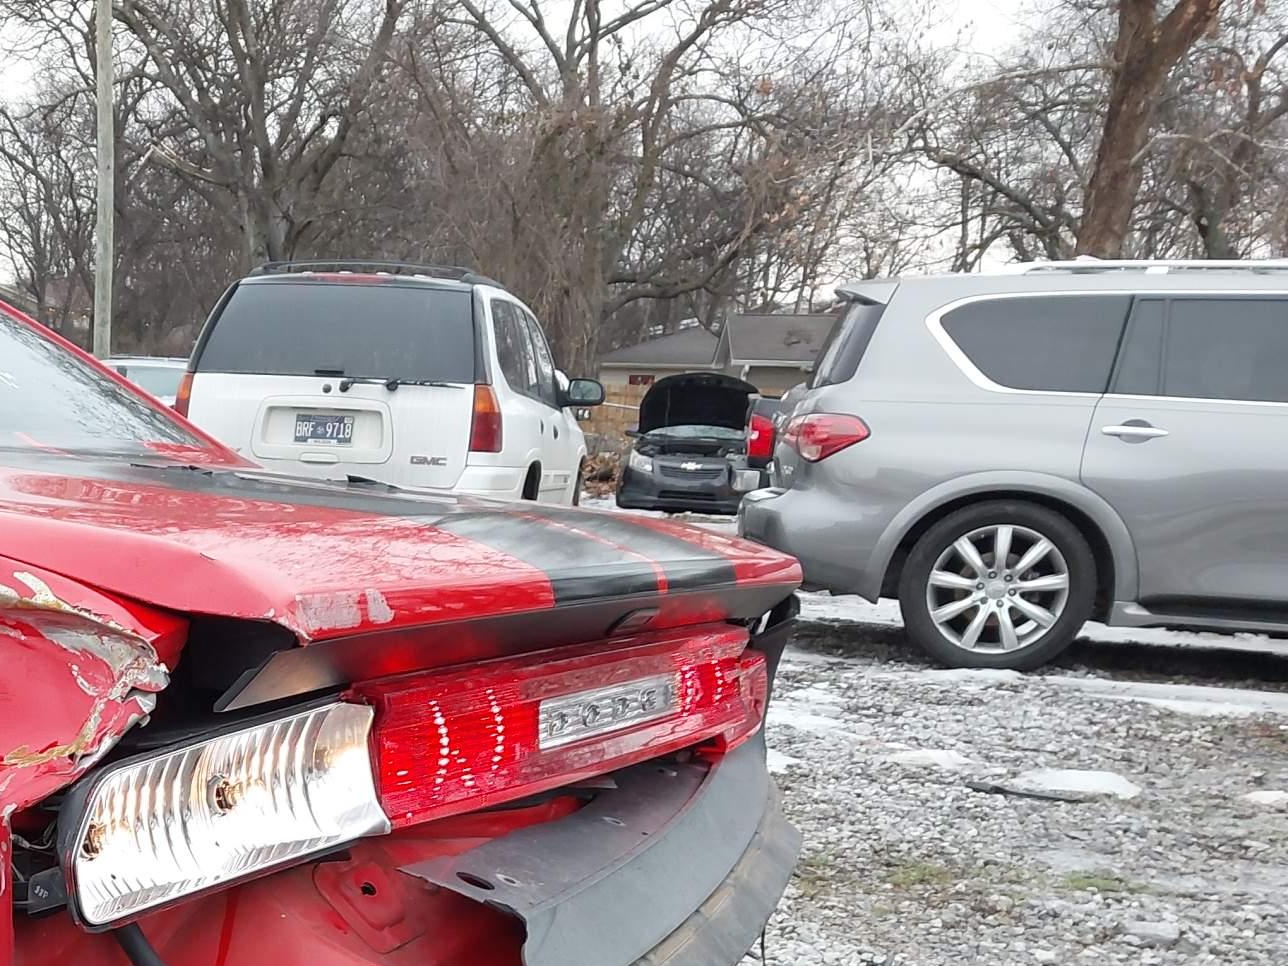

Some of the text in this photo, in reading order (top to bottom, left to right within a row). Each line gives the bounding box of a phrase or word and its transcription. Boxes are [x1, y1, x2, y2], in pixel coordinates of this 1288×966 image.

[296, 421, 352, 438] BRF 9718
[410, 455, 447, 466] GMC
